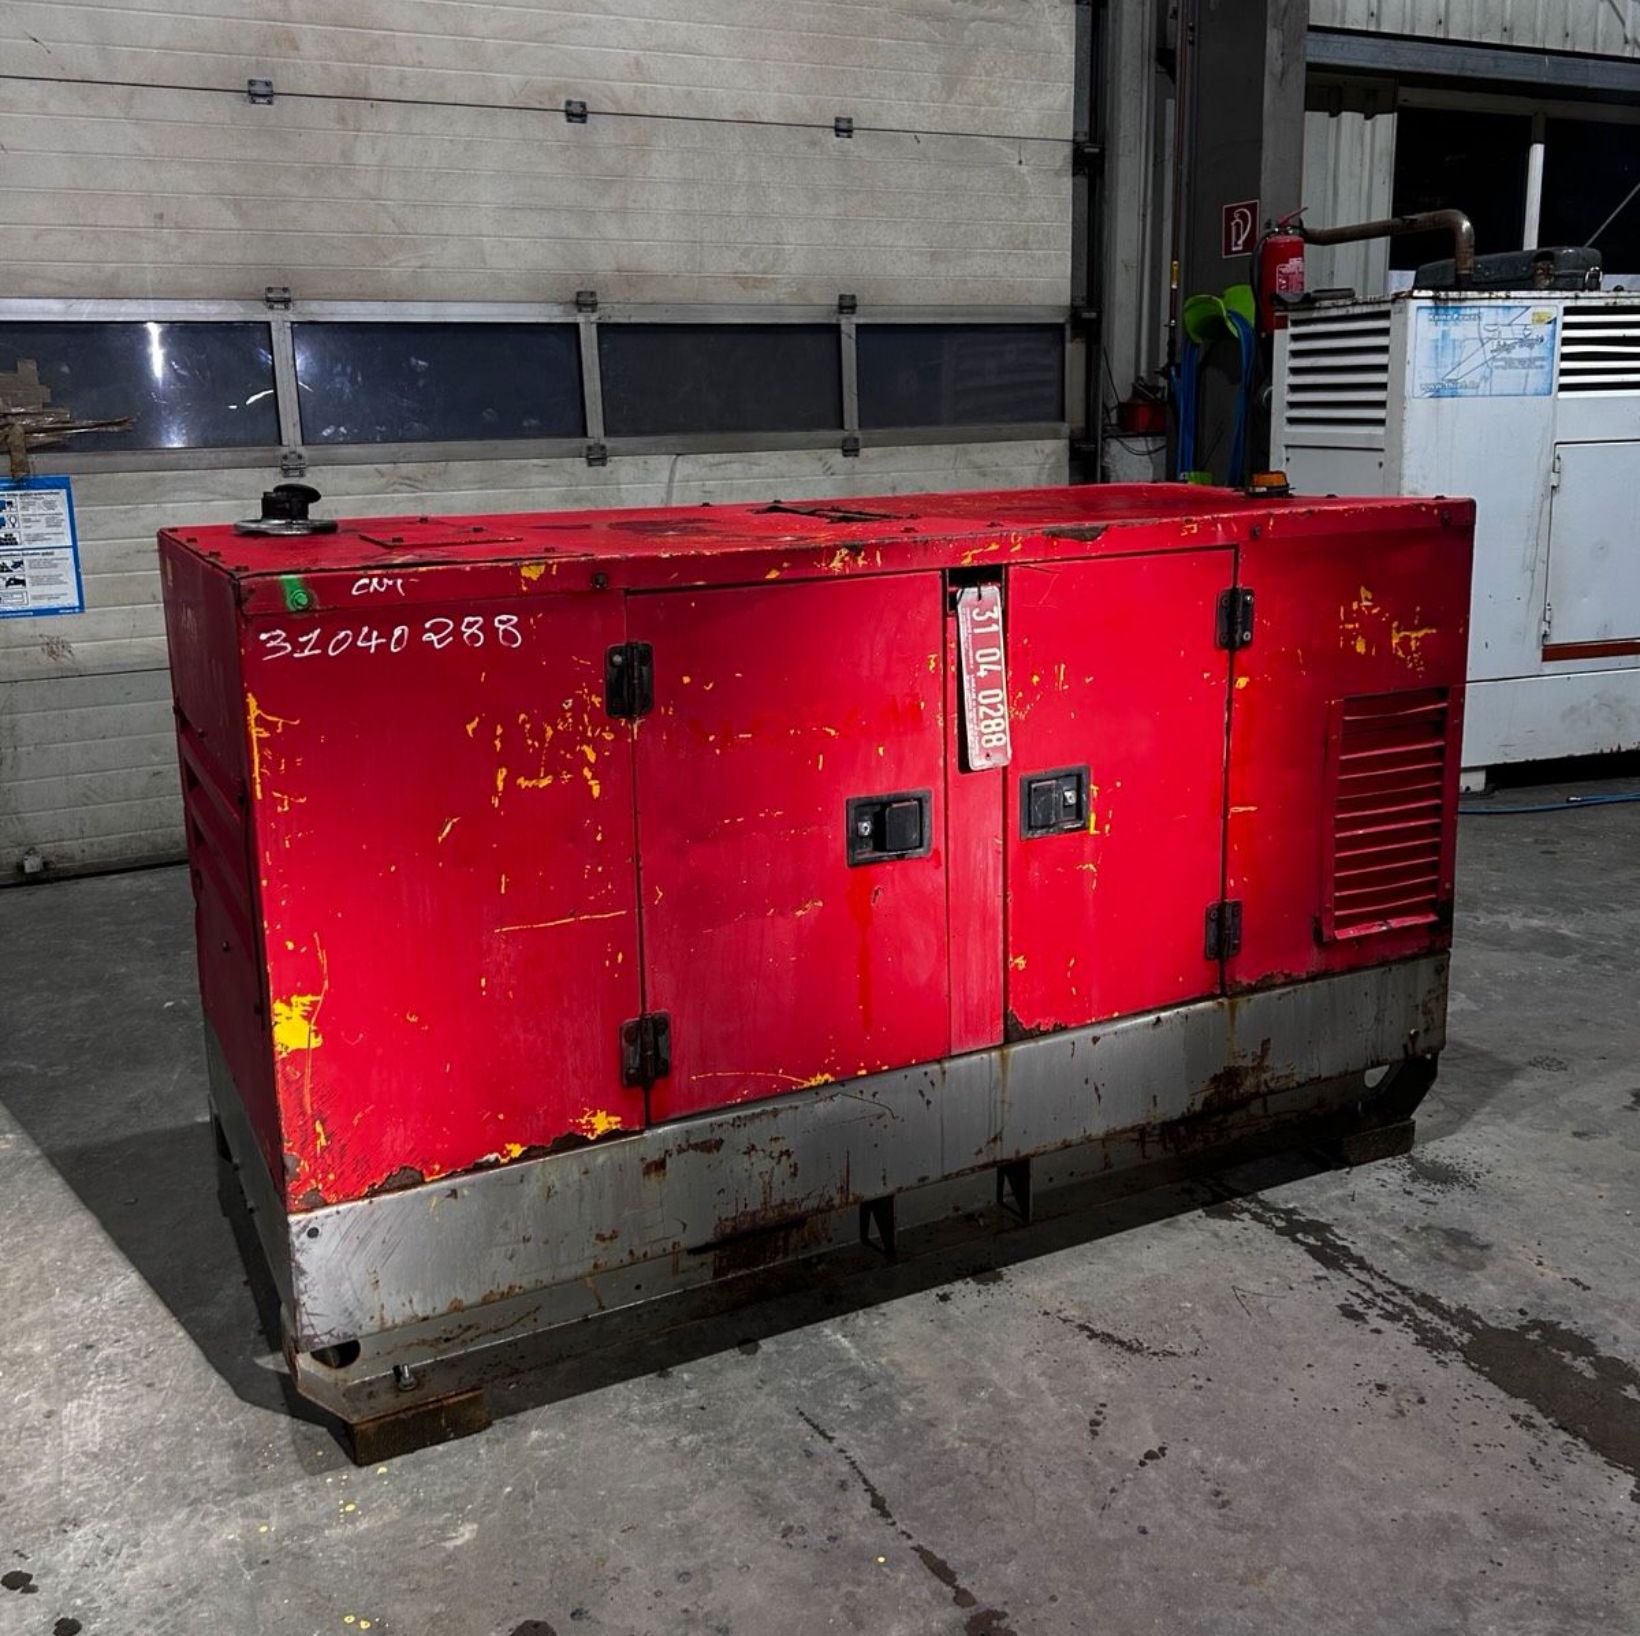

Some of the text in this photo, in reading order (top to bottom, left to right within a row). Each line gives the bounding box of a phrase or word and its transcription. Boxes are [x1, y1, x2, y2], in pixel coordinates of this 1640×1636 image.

[972, 607, 1008, 748] 31 04 0288
